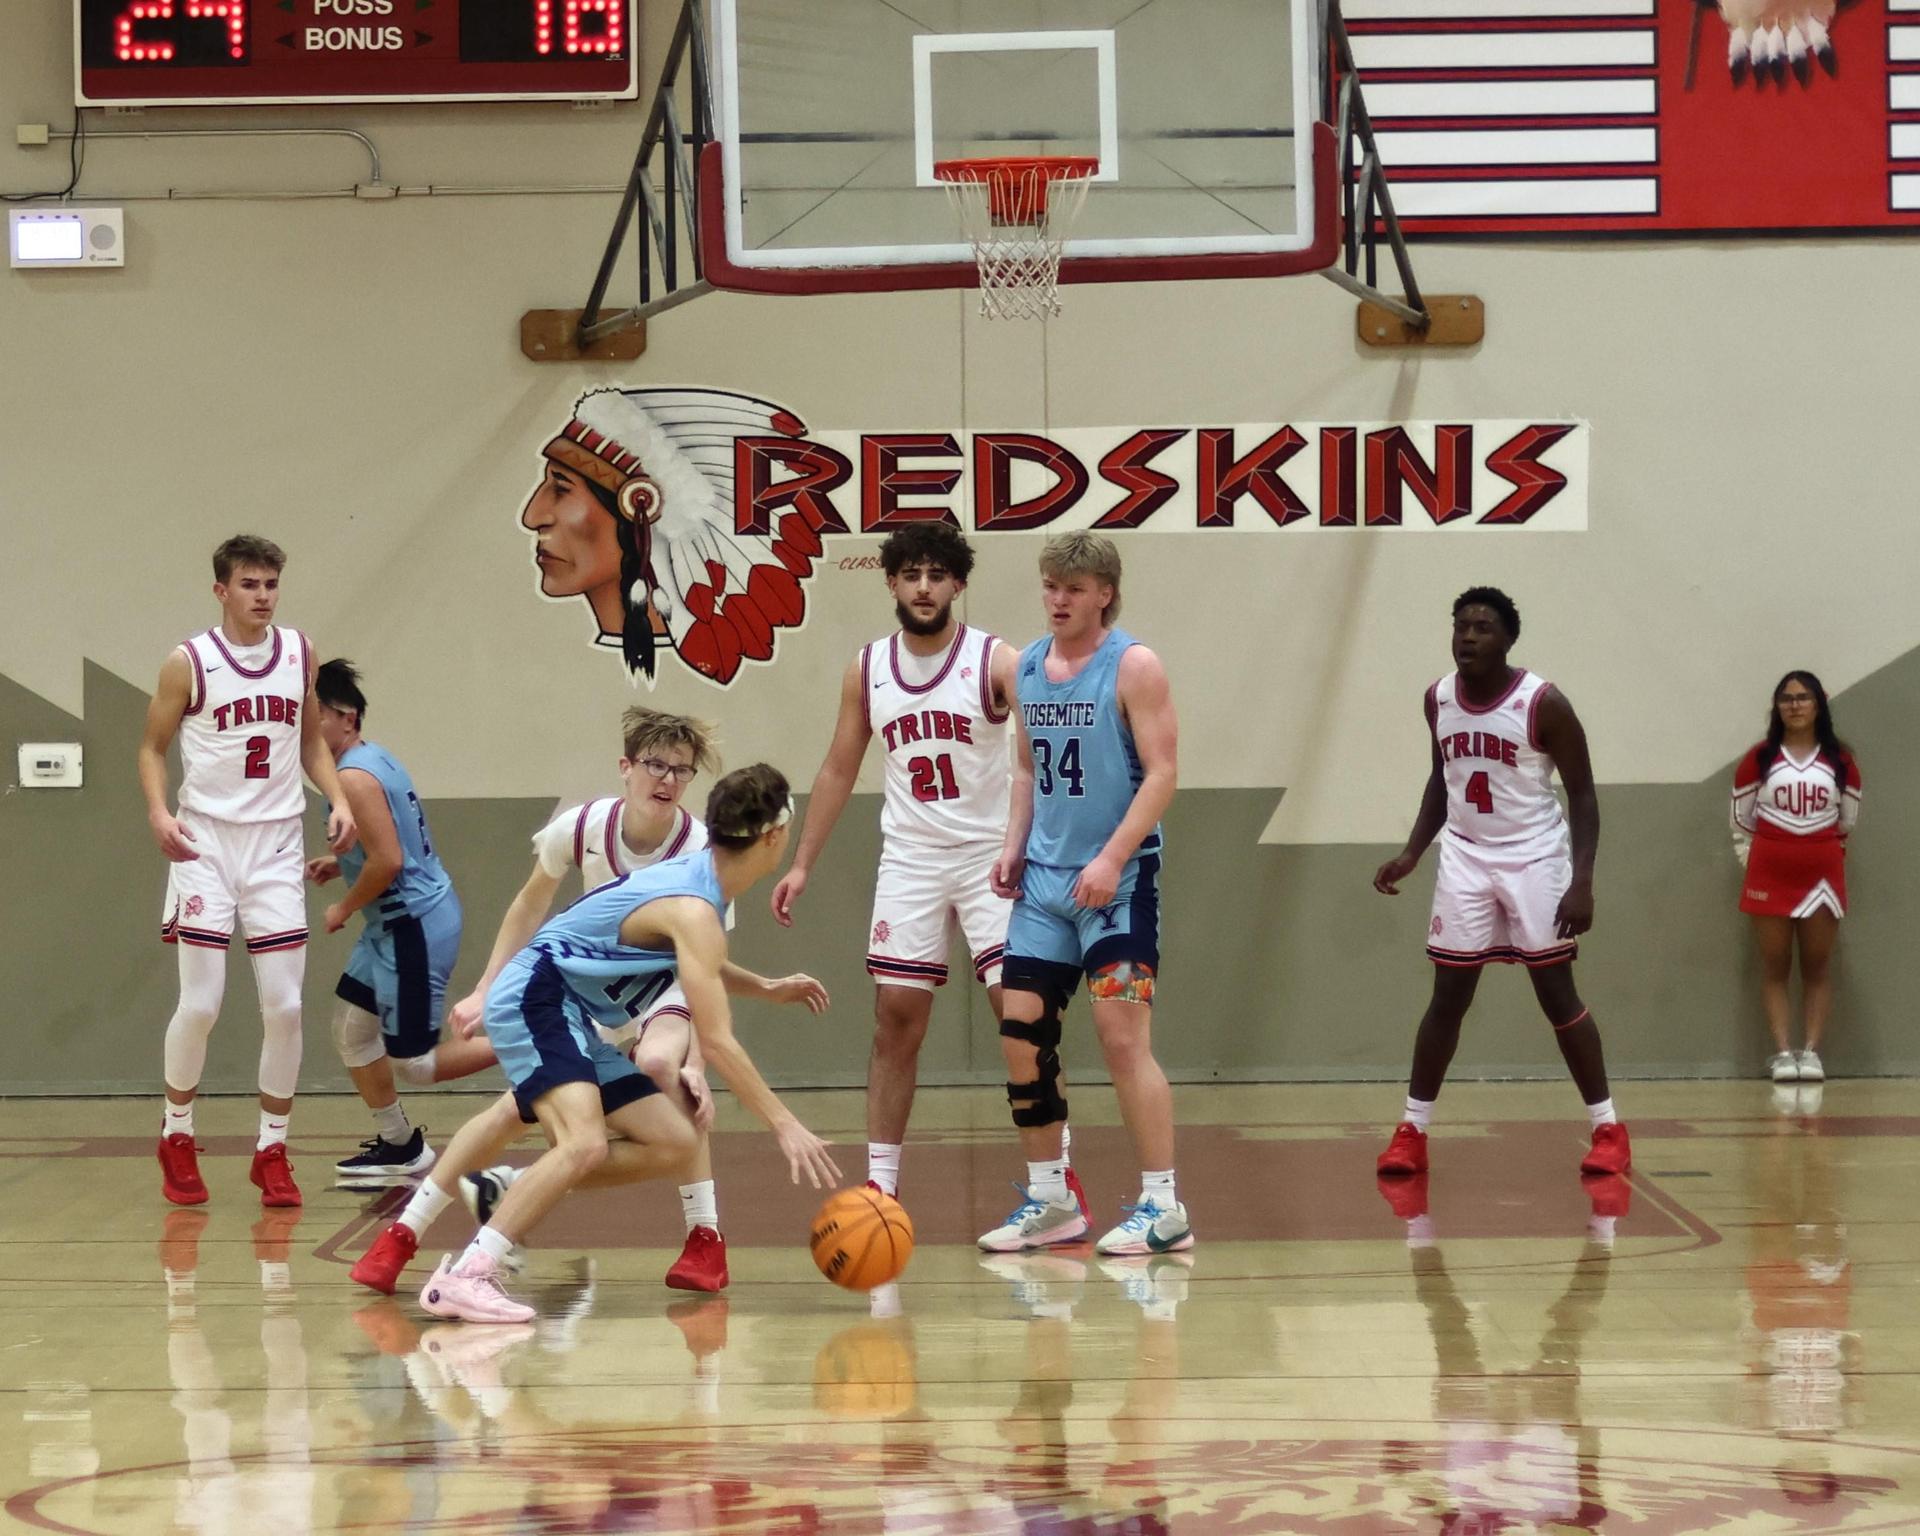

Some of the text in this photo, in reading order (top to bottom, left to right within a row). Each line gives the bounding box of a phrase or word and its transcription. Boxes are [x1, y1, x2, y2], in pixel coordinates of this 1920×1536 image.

[314, 0, 393, 15] POSS
[305, 27, 403, 50] BONUS
[733, 424, 1578, 535] REDSKINS
[213, 695, 299, 732] TRIBE
[882, 710, 974, 753] TRIBE
[1023, 702, 1095, 728] YOSEMITE
[244, 736, 270, 778] 2
[1032, 737, 1086, 796] 34
[1440, 731, 1519, 768] TRIBE
[908, 753, 960, 802] 21
[1465, 771, 1494, 813] 4
[1774, 782, 1829, 816] CUHS
